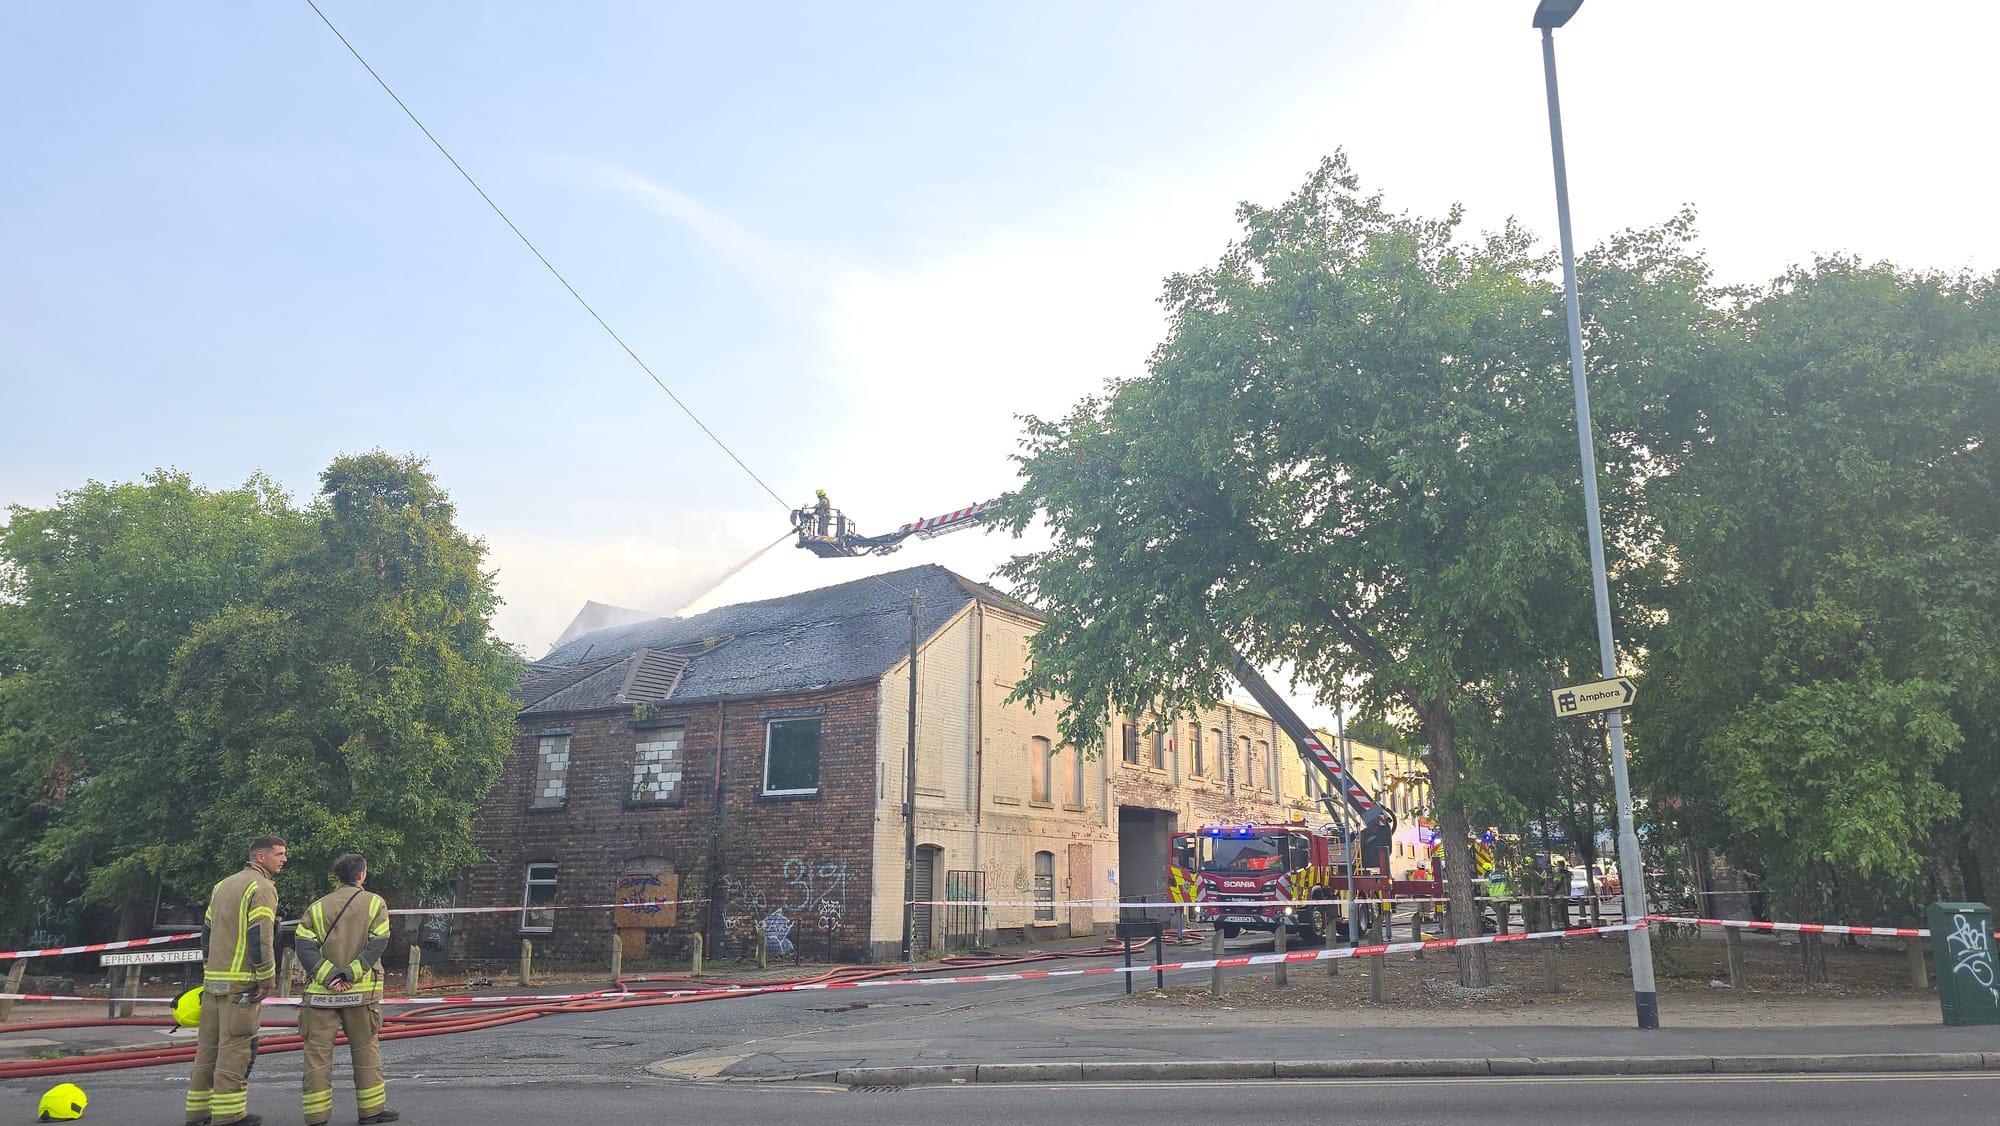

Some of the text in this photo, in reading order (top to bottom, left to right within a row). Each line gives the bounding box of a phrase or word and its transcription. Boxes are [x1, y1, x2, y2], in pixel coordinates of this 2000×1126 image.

[1580, 690, 1620, 702] Amphora
[105, 951, 200, 964] EPHRAIM STREET
[335, 995, 360, 1003] RESCUE
